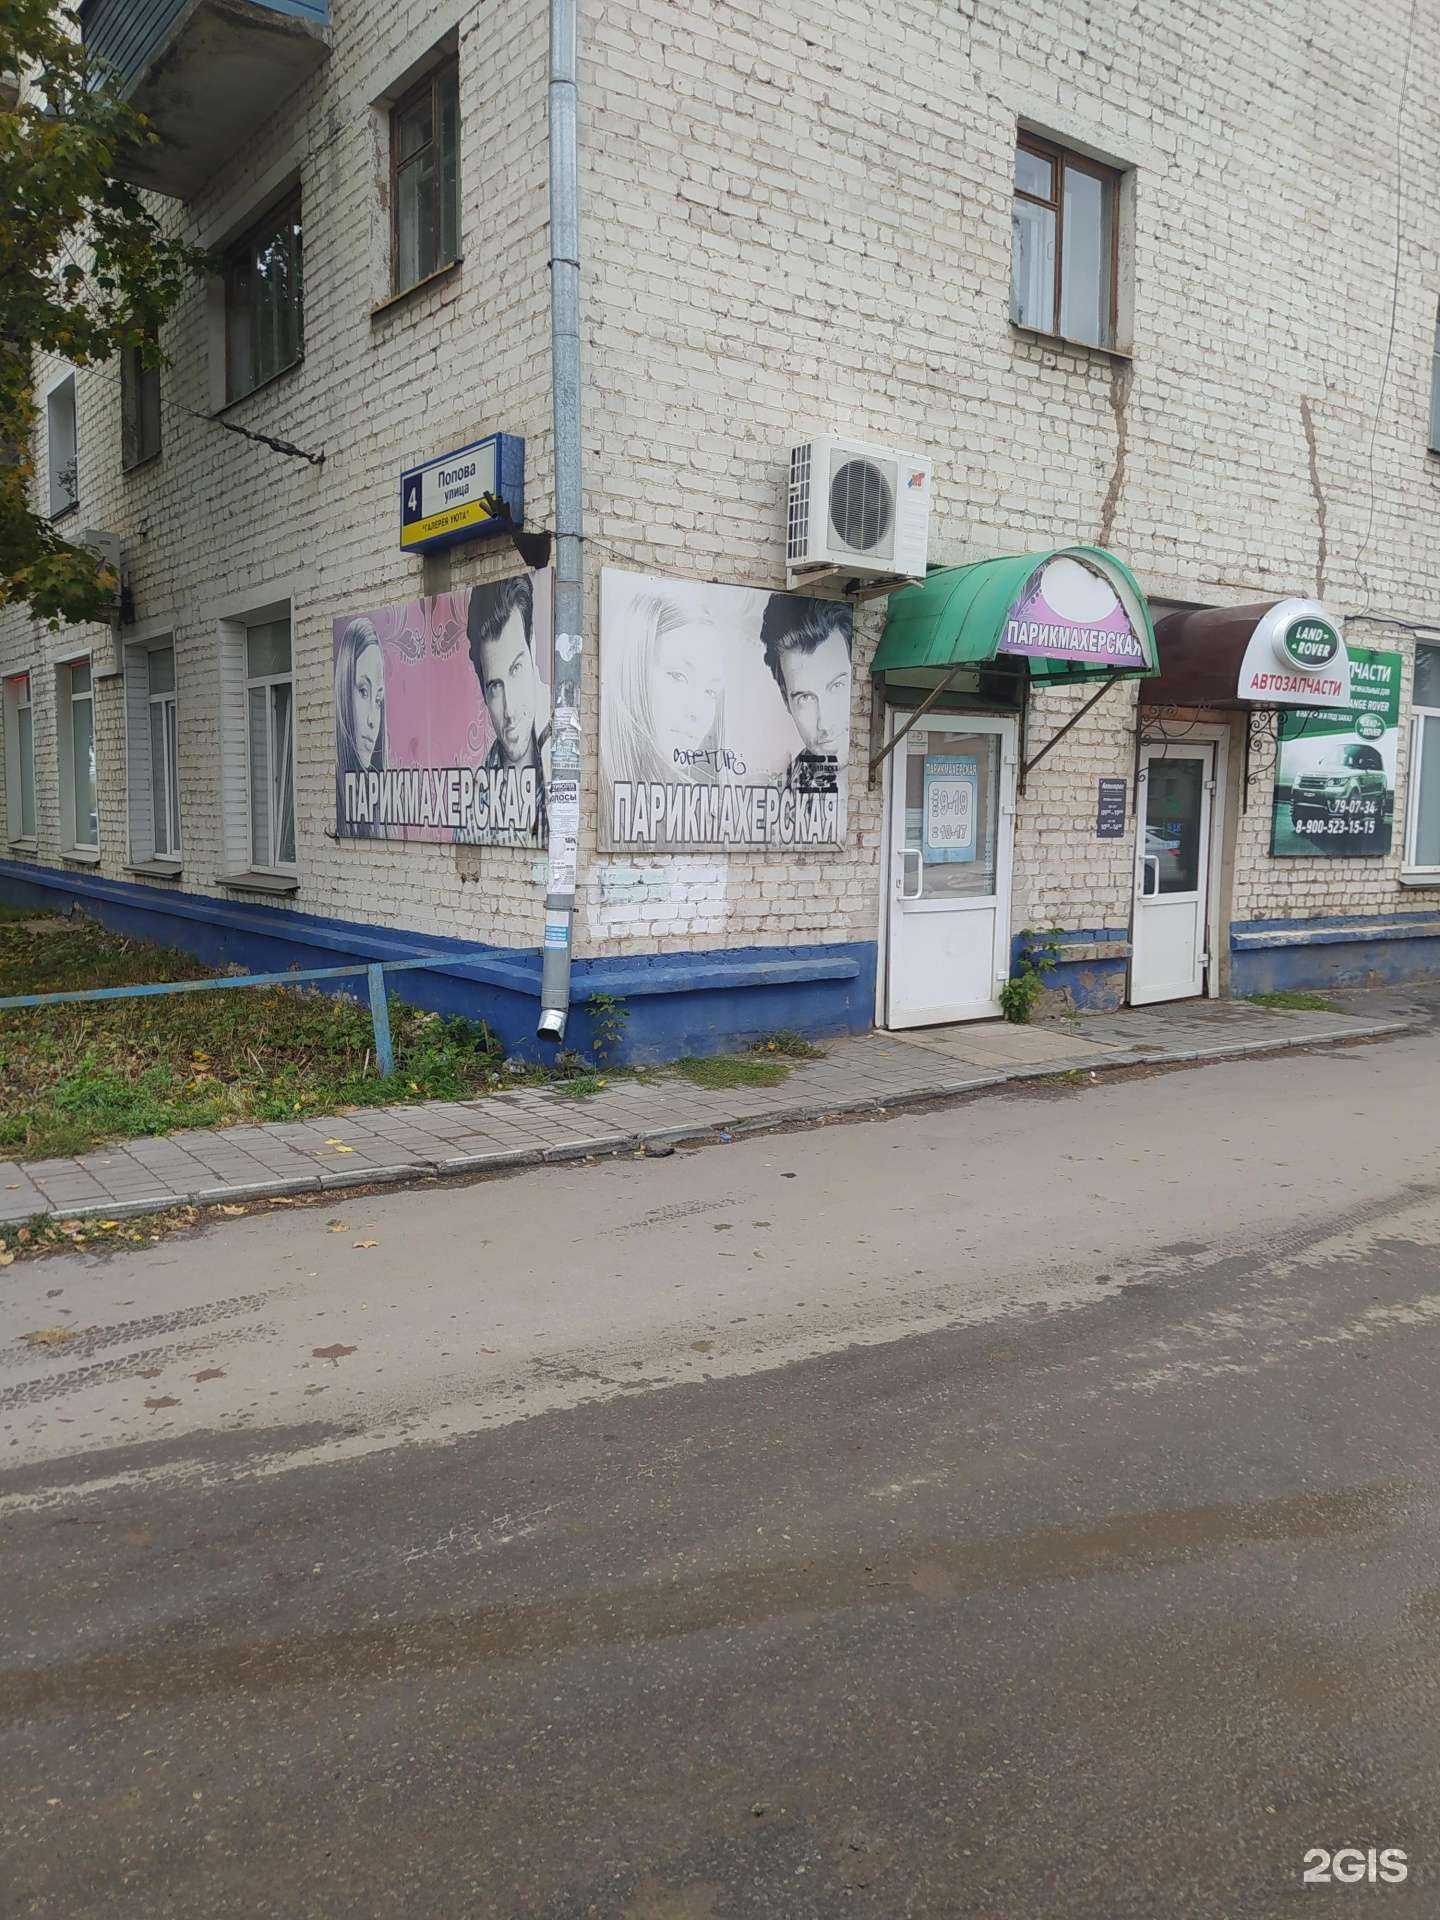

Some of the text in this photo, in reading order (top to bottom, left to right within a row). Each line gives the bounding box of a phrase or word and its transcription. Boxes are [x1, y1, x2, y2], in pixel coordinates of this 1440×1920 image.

[438, 462, 476, 488] Попова
[407, 486, 418, 512] 4
[444, 483, 470, 504] улица
[1296, 625, 1323, 641] LAND
[1297, 641, 1331, 658] ROVER
[1250, 672, 1343, 697] АВТОЗАПЧАСТИ
[1368, 700, 1390, 712] ROVER
[344, 767, 538, 831] ПАРИКМАХЕРСКАЯ
[1335, 799, 1376, 814] 79-07-34
[613, 781, 839, 844] ПАРИКМАХЕРСКАЯ
[1295, 819, 1376, 834] 8-900-523-15-15
